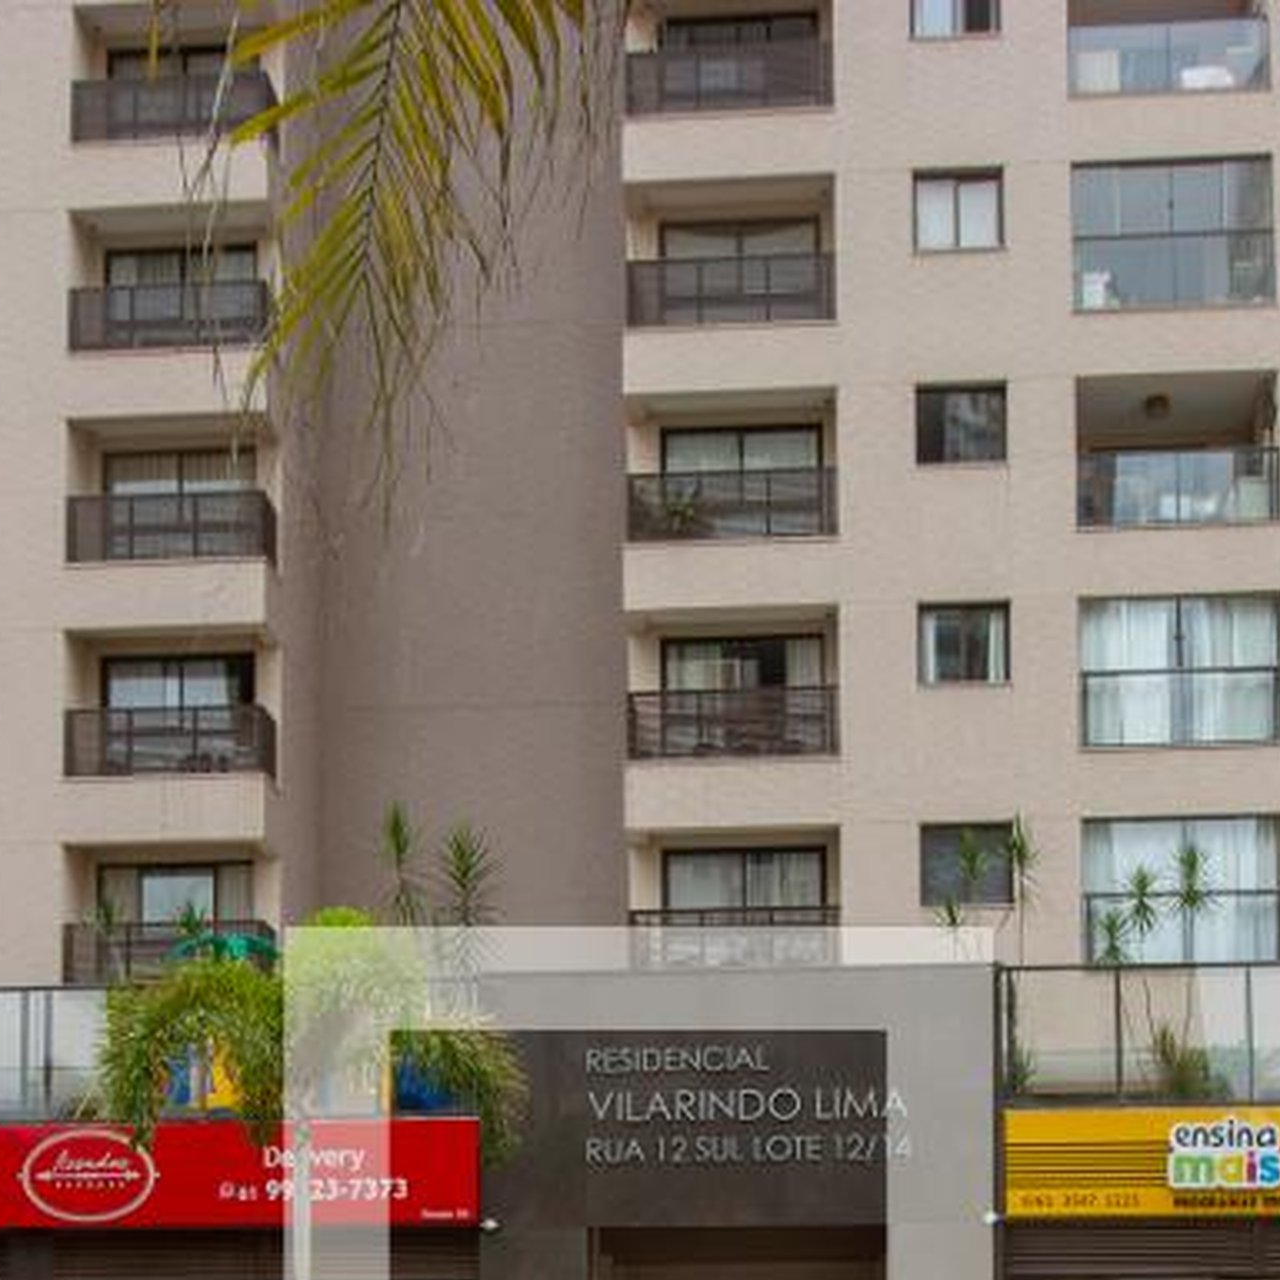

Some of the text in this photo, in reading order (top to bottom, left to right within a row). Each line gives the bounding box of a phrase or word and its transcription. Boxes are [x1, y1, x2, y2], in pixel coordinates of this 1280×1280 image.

[586, 1047, 770, 1072] RESIDENCIAL
[587, 1086, 909, 1122] VILARINDO LIMA
[1175, 1119, 1277, 1148] ensina
[263, 1146, 365, 1171] Devery
[586, 1136, 646, 1163] RUA
[658, 1136, 688, 1162] 12
[695, 1136, 745, 1162] SUL
[751, 1134, 822, 1162] LOTE
[1173, 1151, 1280, 1183] mais
